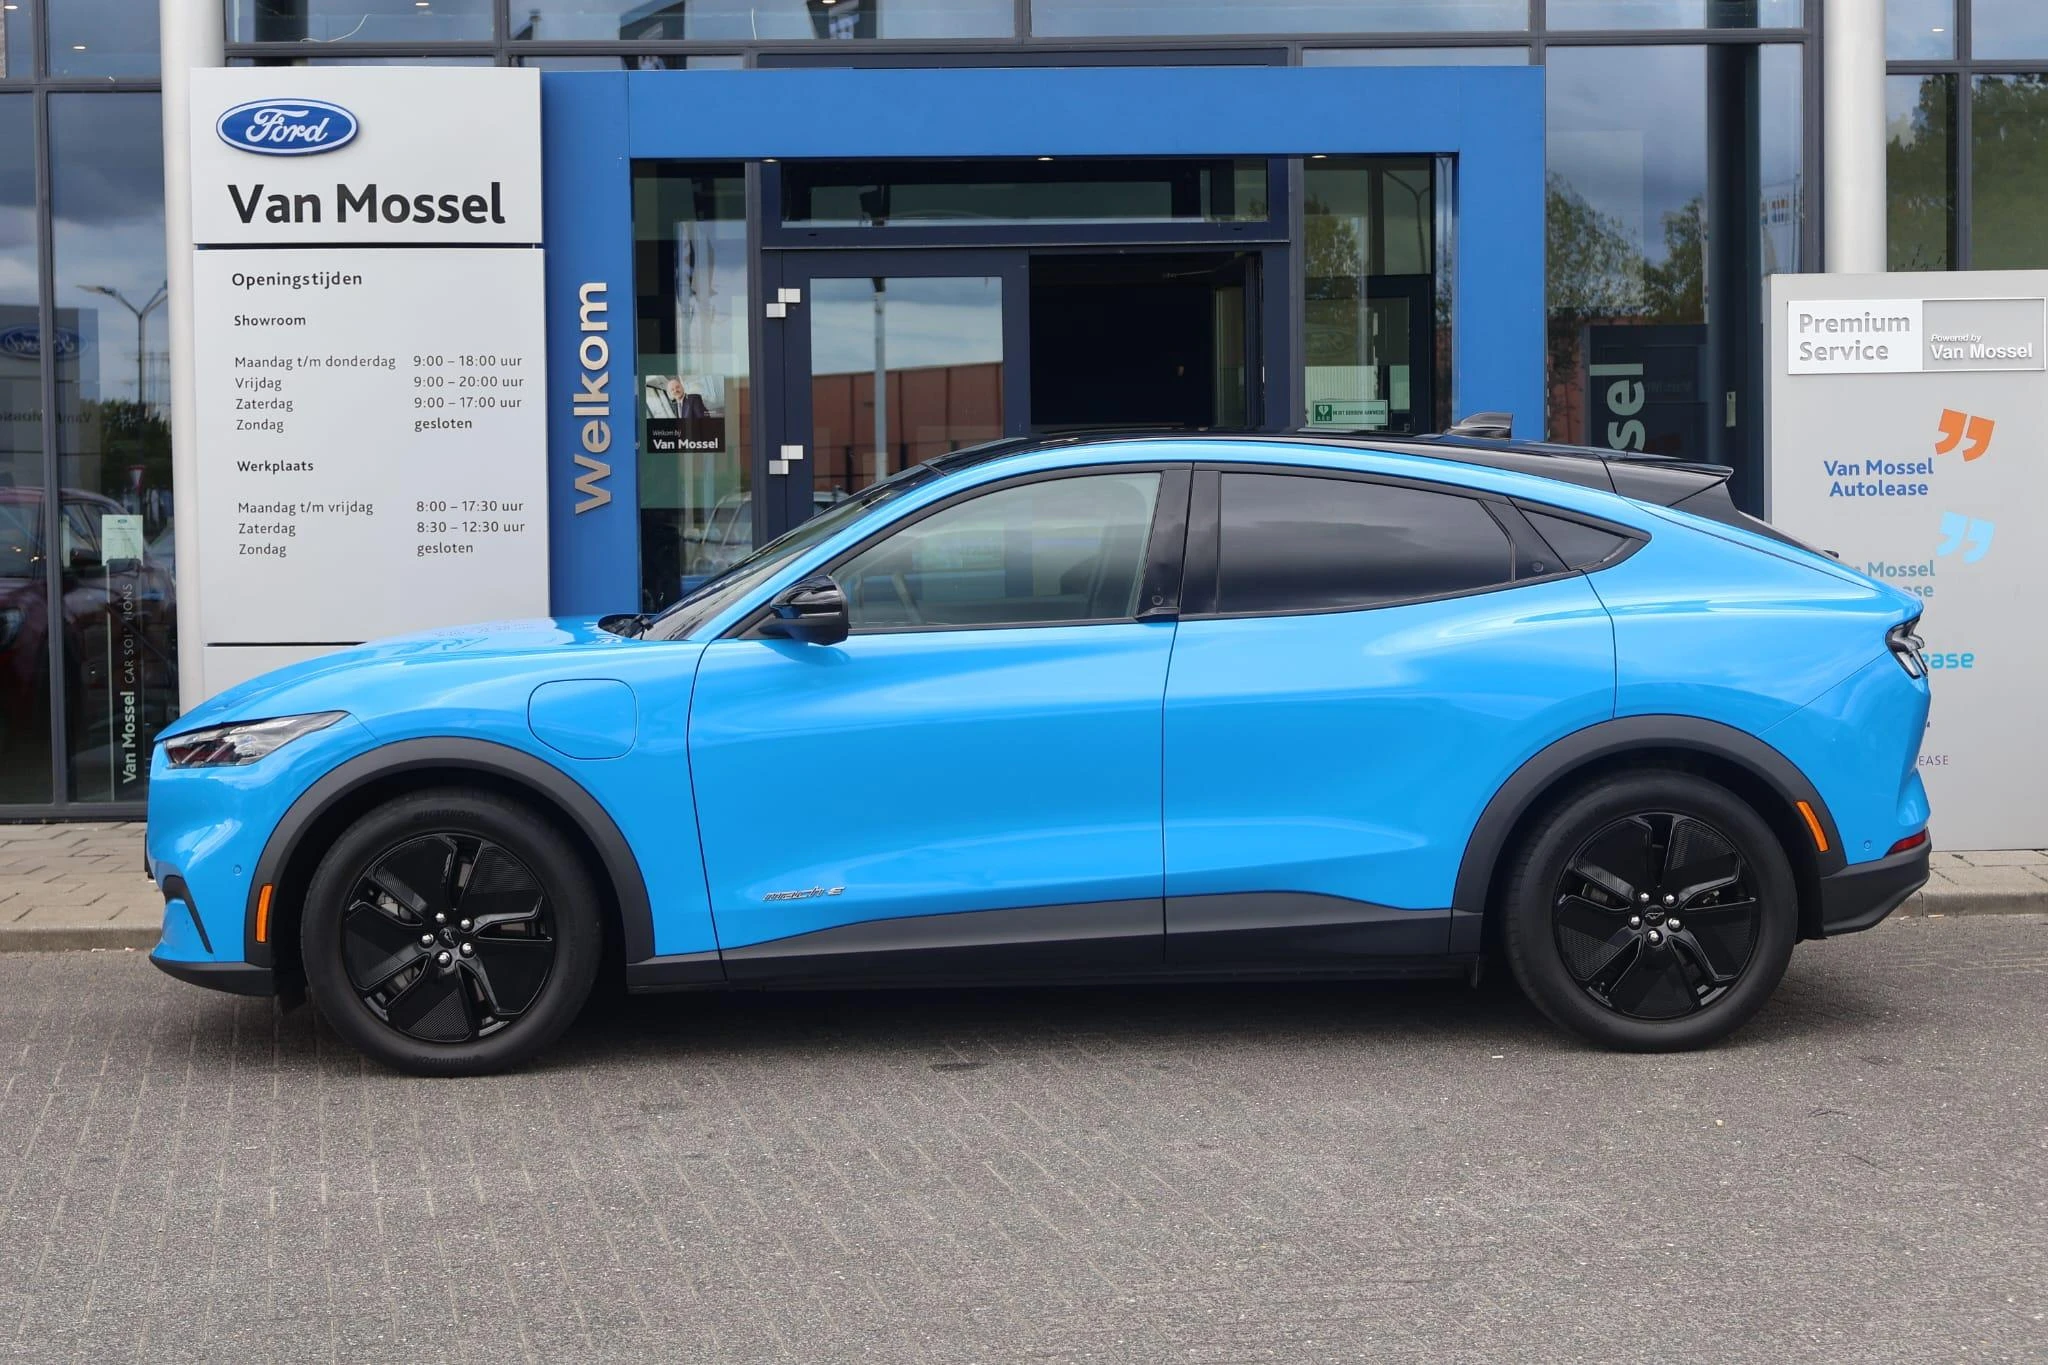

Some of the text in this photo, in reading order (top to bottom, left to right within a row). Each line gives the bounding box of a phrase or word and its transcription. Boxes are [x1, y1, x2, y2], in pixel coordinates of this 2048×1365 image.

[245, 108, 330, 142] Ford
[227, 181, 506, 224] Van Mossel
[232, 271, 363, 290] Openingstijden
[234, 315, 306, 327] Showroom
[1799, 312, 1911, 333] Premium
[1930, 334, 1982, 344] Powered by
[1799, 340, 1889, 361] Service
[1931, 342, 2034, 359] Van Mossel
[235, 355, 293, 371] Maandag
[297, 355, 321, 368] t/m
[325, 355, 396, 370] donderdag
[413, 355, 443, 367] 9:00
[459, 355, 496, 367] 18:00
[500, 356, 522, 367] uur
[235, 377, 282, 392] Vrijdag
[414, 376, 444, 388] 9:00
[459, 376, 498, 388] 20:00
[502, 377, 524, 388] uur
[236, 398, 293, 413] Zaterdag
[414, 397, 444, 408] 9:00
[459, 397, 496, 408] 17:00
[500, 398, 522, 408] uur
[573, 282, 611, 515] Welkom
[1589, 363, 1646, 451] sel
[236, 417, 472, 433] Zondag gesloten
[653, 438, 718, 449] Van Mossel
[237, 461, 314, 474] Werkplaats
[1823, 457, 1934, 476] Van Mossel
[1829, 479, 1929, 497] Autolease
[238, 501, 296, 516] Maandag
[300, 501, 324, 513] t/m
[328, 501, 373, 516] vrijdag
[416, 501, 446, 512] 8:00
[463, 500, 497, 512] 17:30
[502, 501, 524, 512] uur
[238, 522, 296, 537] Zaterdag
[417, 521, 447, 533] 8:30
[463, 521, 499, 533] 12:30
[503, 522, 525, 532] uur
[239, 541, 473, 557] Zondag gesloten
[1867, 560, 1935, 577] Mossel
[124, 660, 135, 684] CAR
[120, 691, 137, 784] Van Mossel
[1918, 755, 1949, 766] EASE
